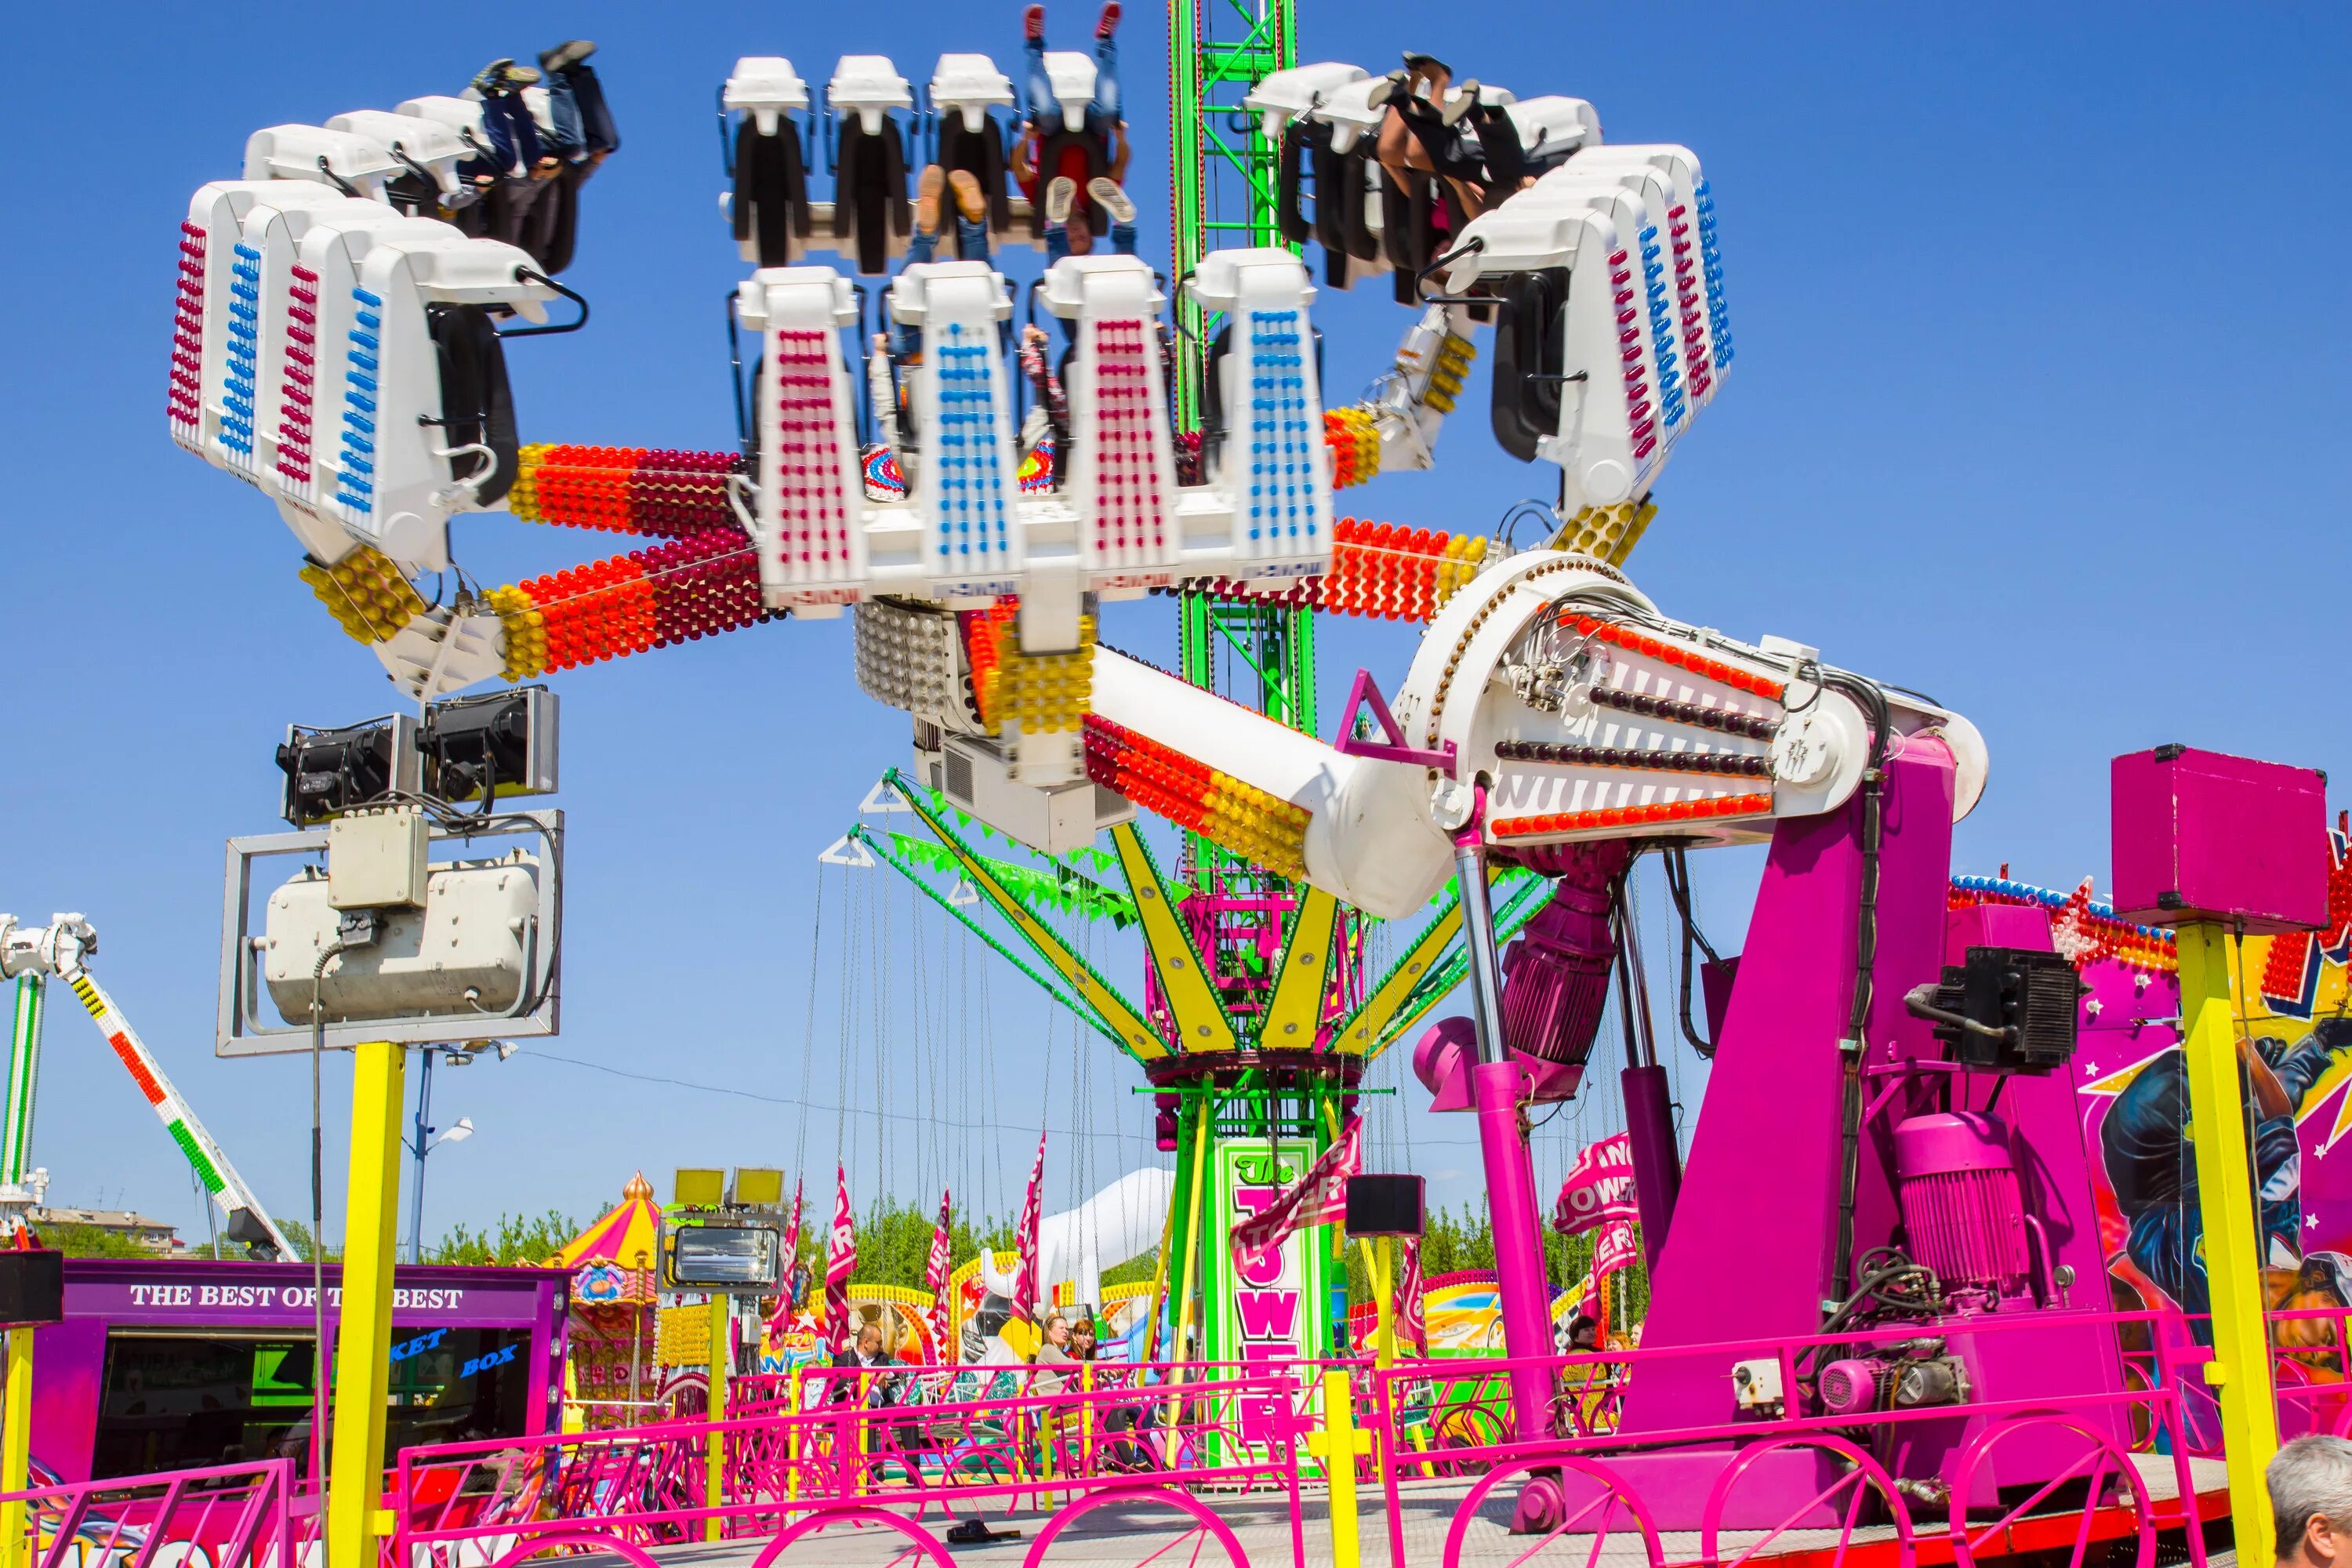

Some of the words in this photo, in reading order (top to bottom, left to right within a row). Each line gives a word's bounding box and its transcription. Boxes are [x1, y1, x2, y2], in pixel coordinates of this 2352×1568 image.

[130, 1285, 191, 1306] THE
[199, 1286, 275, 1307] BEST
[393, 1289, 463, 1308] BEST
[389, 1327, 447, 1364] KET
[460, 1344, 518, 1378] BOX
